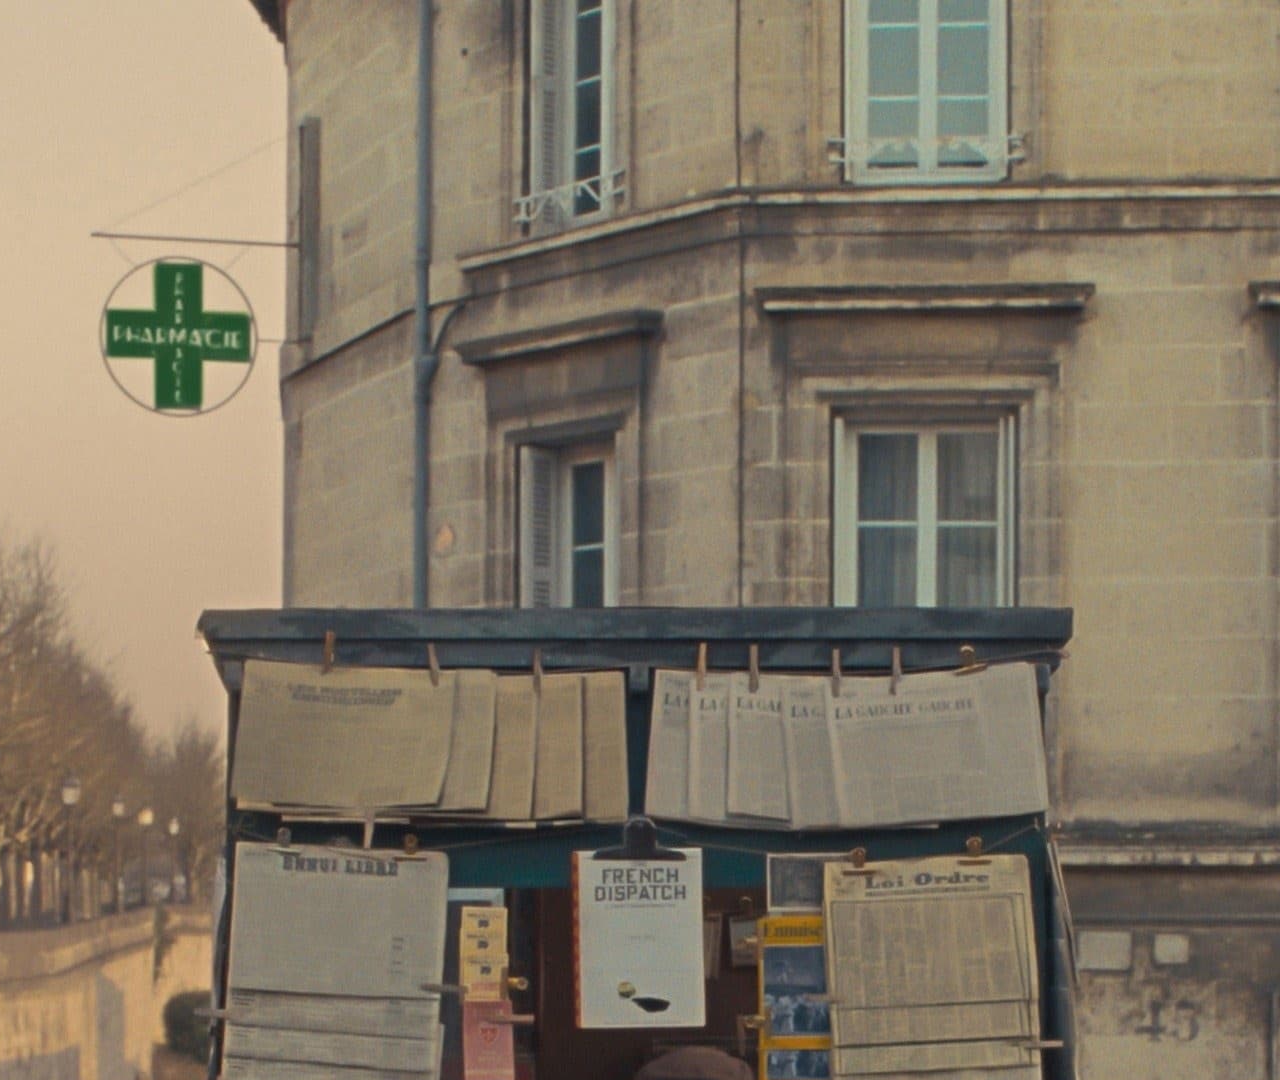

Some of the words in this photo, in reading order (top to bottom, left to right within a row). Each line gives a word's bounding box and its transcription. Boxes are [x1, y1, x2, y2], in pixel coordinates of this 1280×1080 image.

[112, 325, 242, 349] PHARMACIE
[345, 859, 398, 876] LIBRE
[601, 867, 679, 885] FRENCH
[865, 873, 904, 890] Loi
[914, 871, 989, 887] Ordre
[594, 885, 687, 902] DISPATCH
